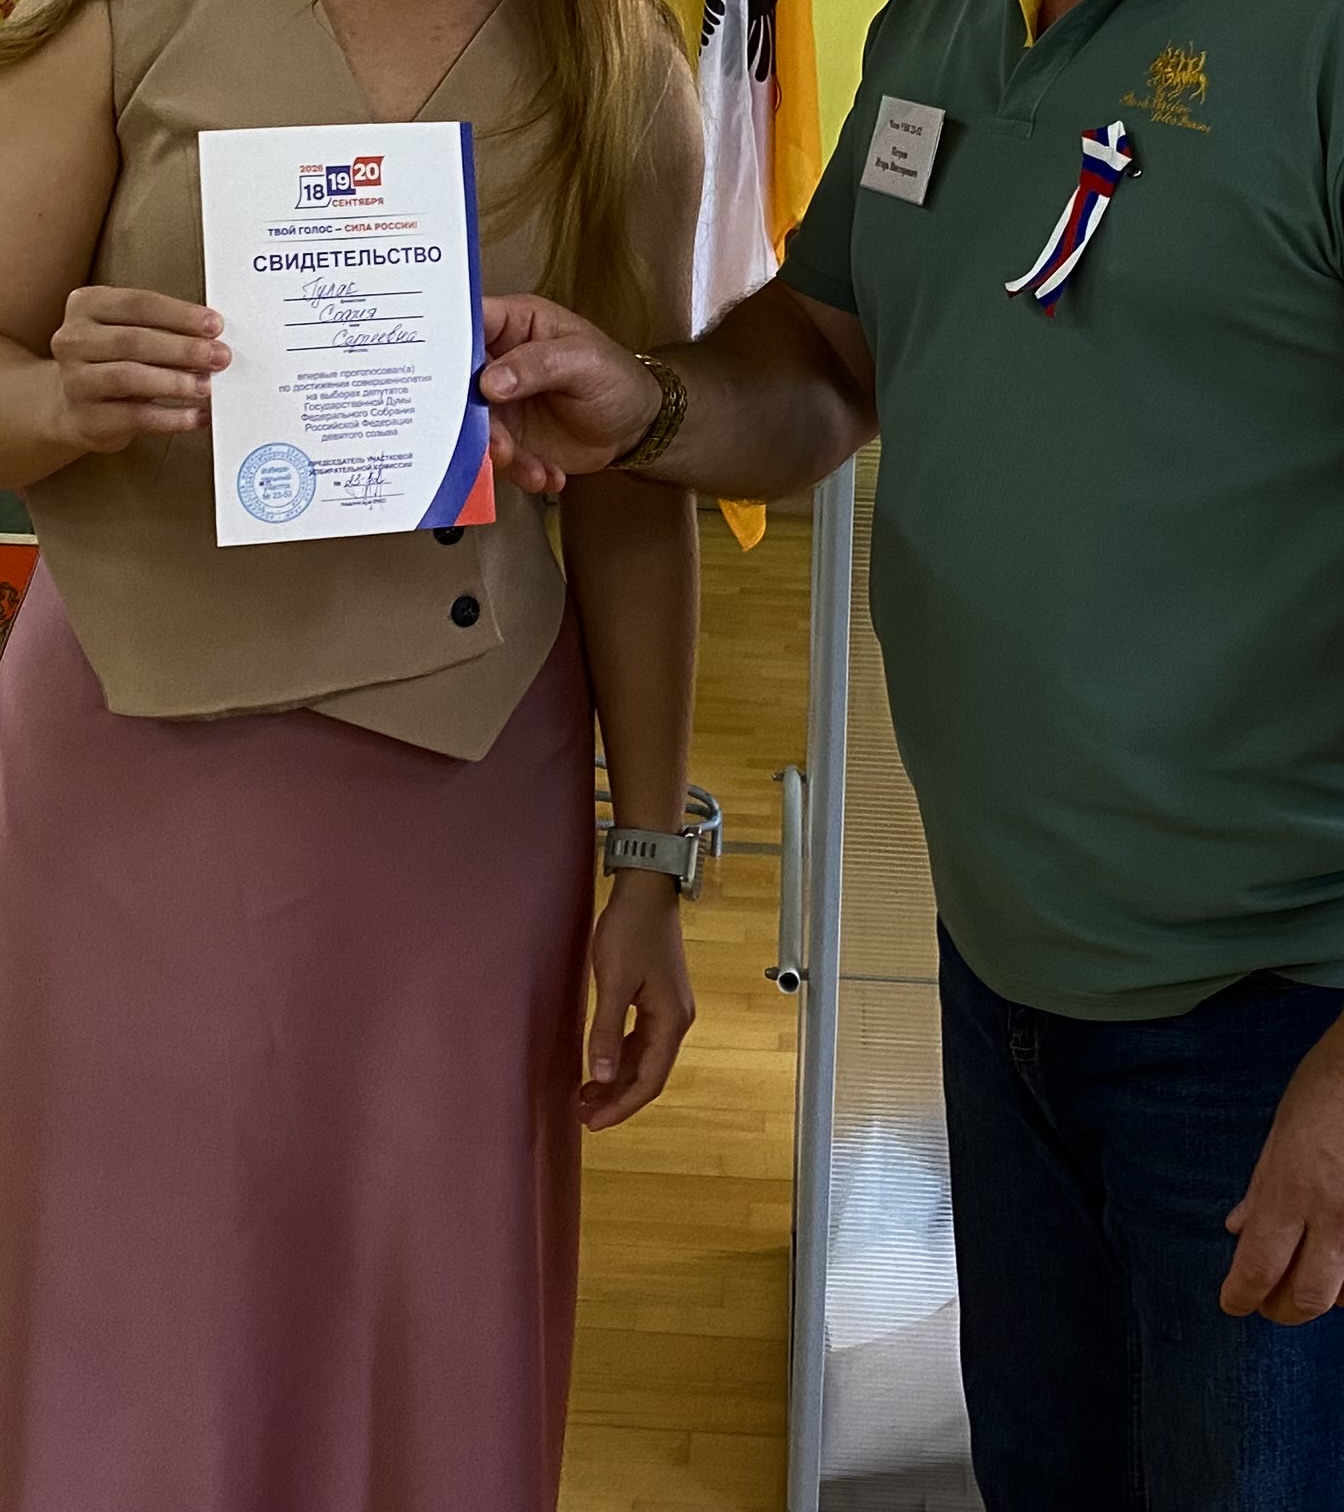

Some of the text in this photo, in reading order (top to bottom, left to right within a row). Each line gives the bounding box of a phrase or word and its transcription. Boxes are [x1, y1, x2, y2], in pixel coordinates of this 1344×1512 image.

[353, 163, 380, 181] 20
[328, 172, 350, 190] 19
[303, 184, 325, 201] 18
[332, 197, 384, 207] СЕНТЯБРЯ
[268, 225, 296, 236] ТВОЙ
[299, 225, 333, 235] ГОЛОС
[344, 222, 373, 233] СИЛА
[375, 221, 418, 232] РОССИИ!
[253, 246, 442, 272] СВИДЕТЕЛЬСТВО
[297, 371, 338, 381] впервые
[370, 406, 415, 418] Собрания
